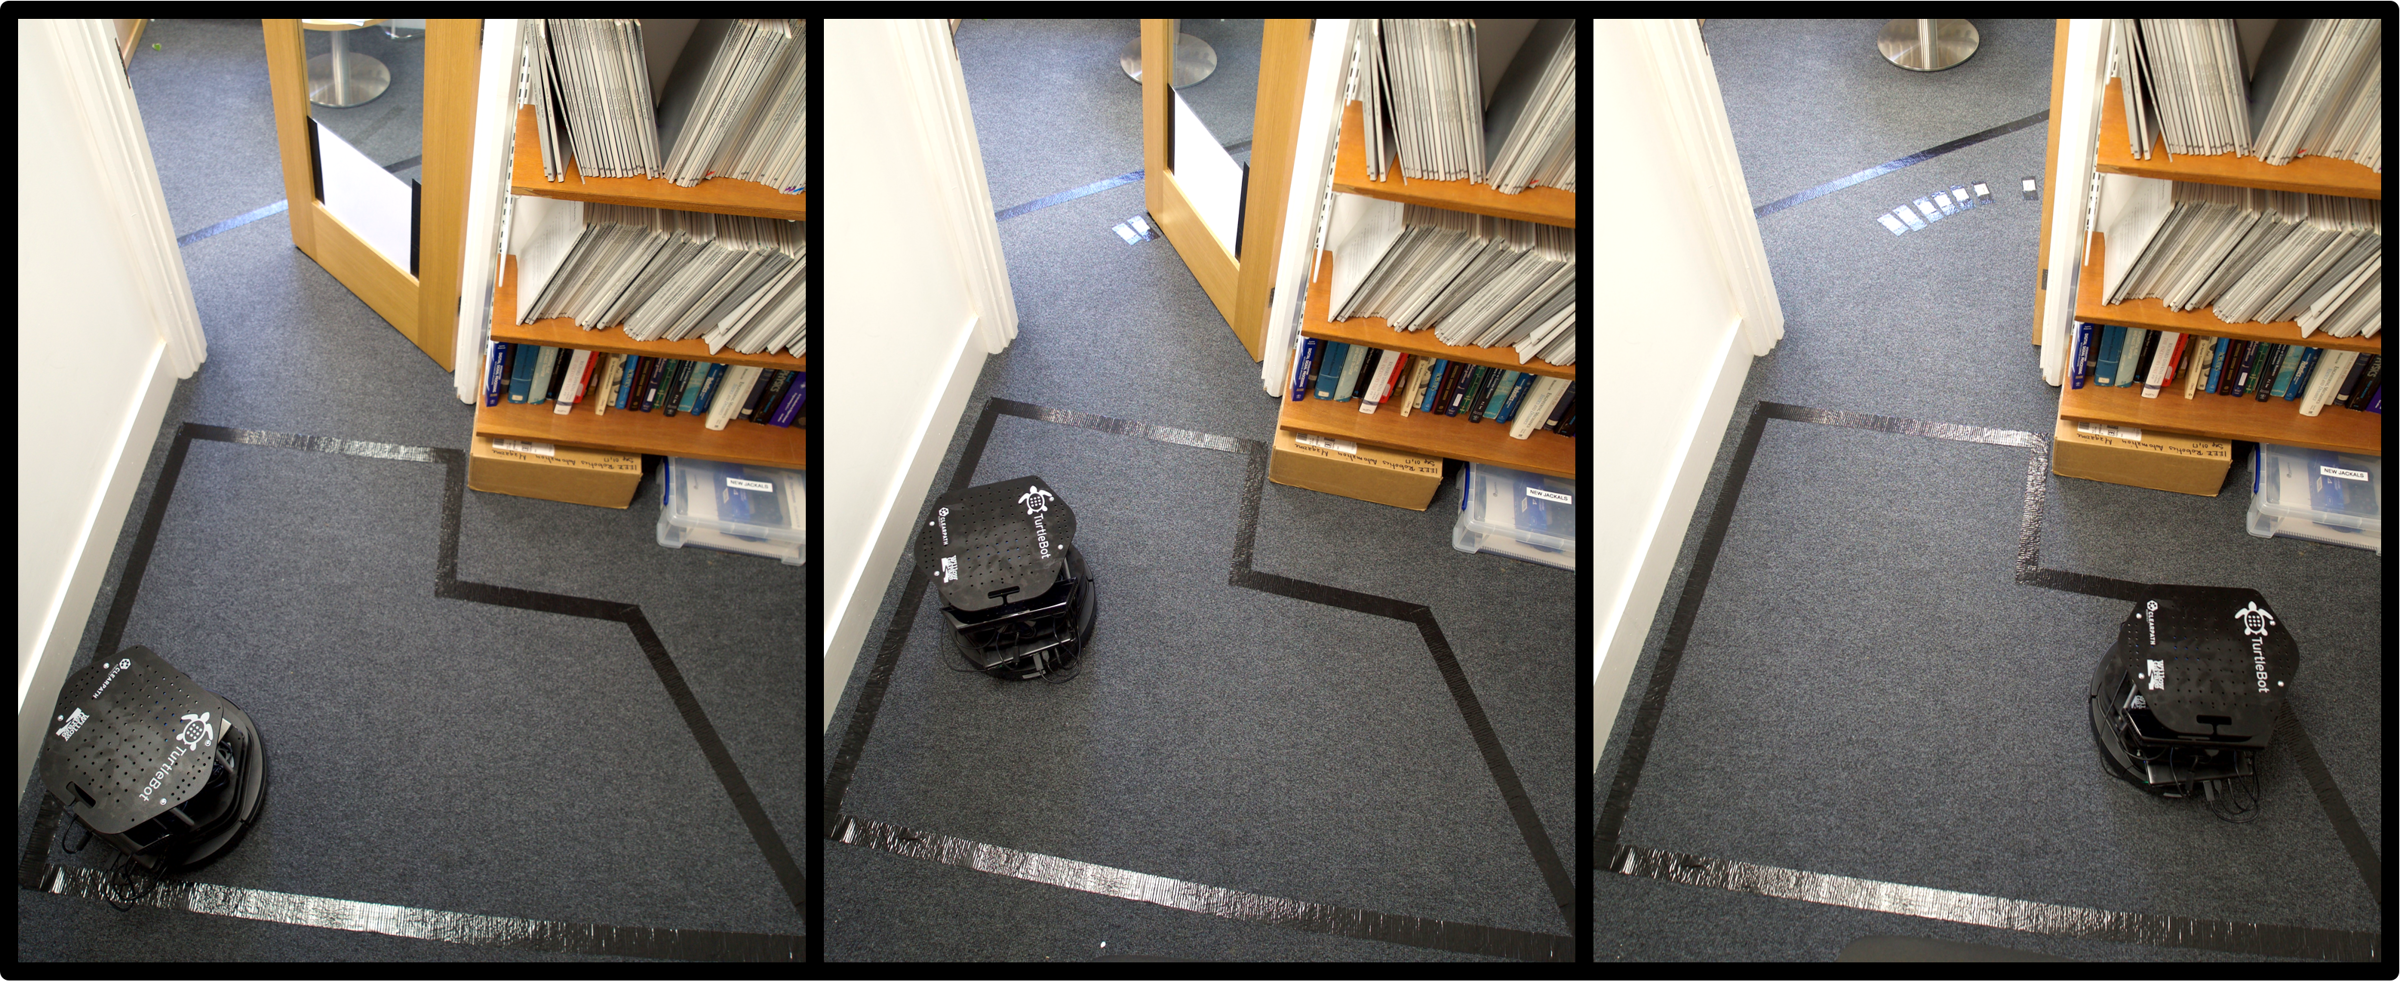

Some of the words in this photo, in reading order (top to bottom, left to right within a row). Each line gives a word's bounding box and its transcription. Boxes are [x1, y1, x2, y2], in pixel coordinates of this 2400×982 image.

[2338, 470, 2364, 478] JACKALS
[1543, 491, 1568, 501] JACKALS
[1034, 513, 1051, 559] TurtleBot
[92, 667, 120, 699] CLEARPATH
[2252, 637, 2270, 693] TurtleBot
[139, 746, 186, 801] TurtleBot
